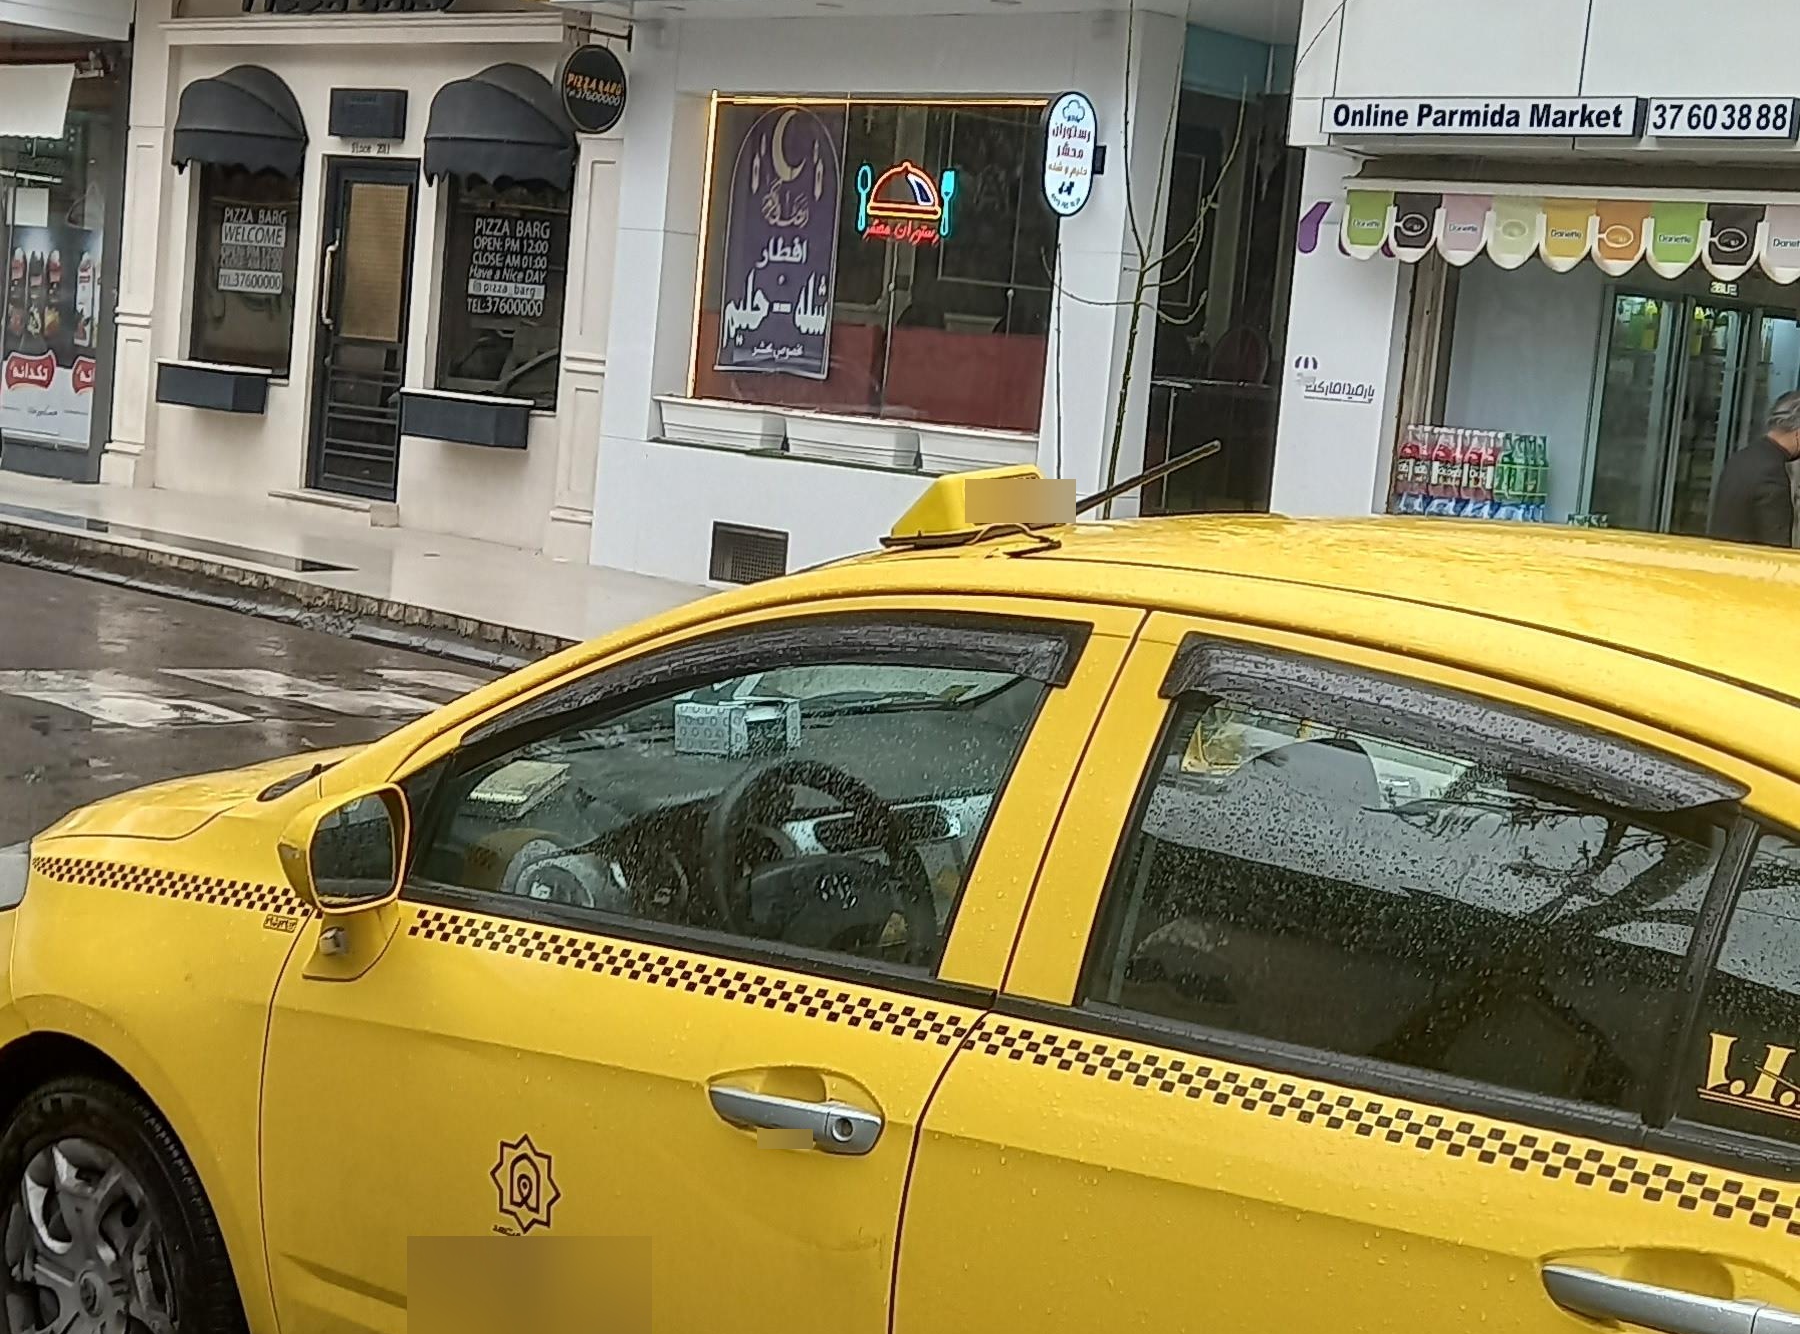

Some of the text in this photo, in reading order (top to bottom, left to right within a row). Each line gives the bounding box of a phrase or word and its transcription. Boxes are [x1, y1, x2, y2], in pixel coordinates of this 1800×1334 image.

[567, 73, 597, 92] PIZZA
[1333, 103, 1622, 128] Online Parmida Market
[1052, 123, 1091, 142] رستوران
[1057, 142, 1084, 158] محشر
[224, 207, 287, 226] PIZZA BARG
[224, 226, 283, 244] WELCOME
[474, 218, 551, 239] PIZZA BARG
[504, 237, 520, 253] PM
[756, 236, 808, 267] افطار
[504, 253, 520, 268] AM
[525, 269, 547, 284] DAY
[723, 268, 770, 348] حلیم
[795, 271, 829, 335] شله
